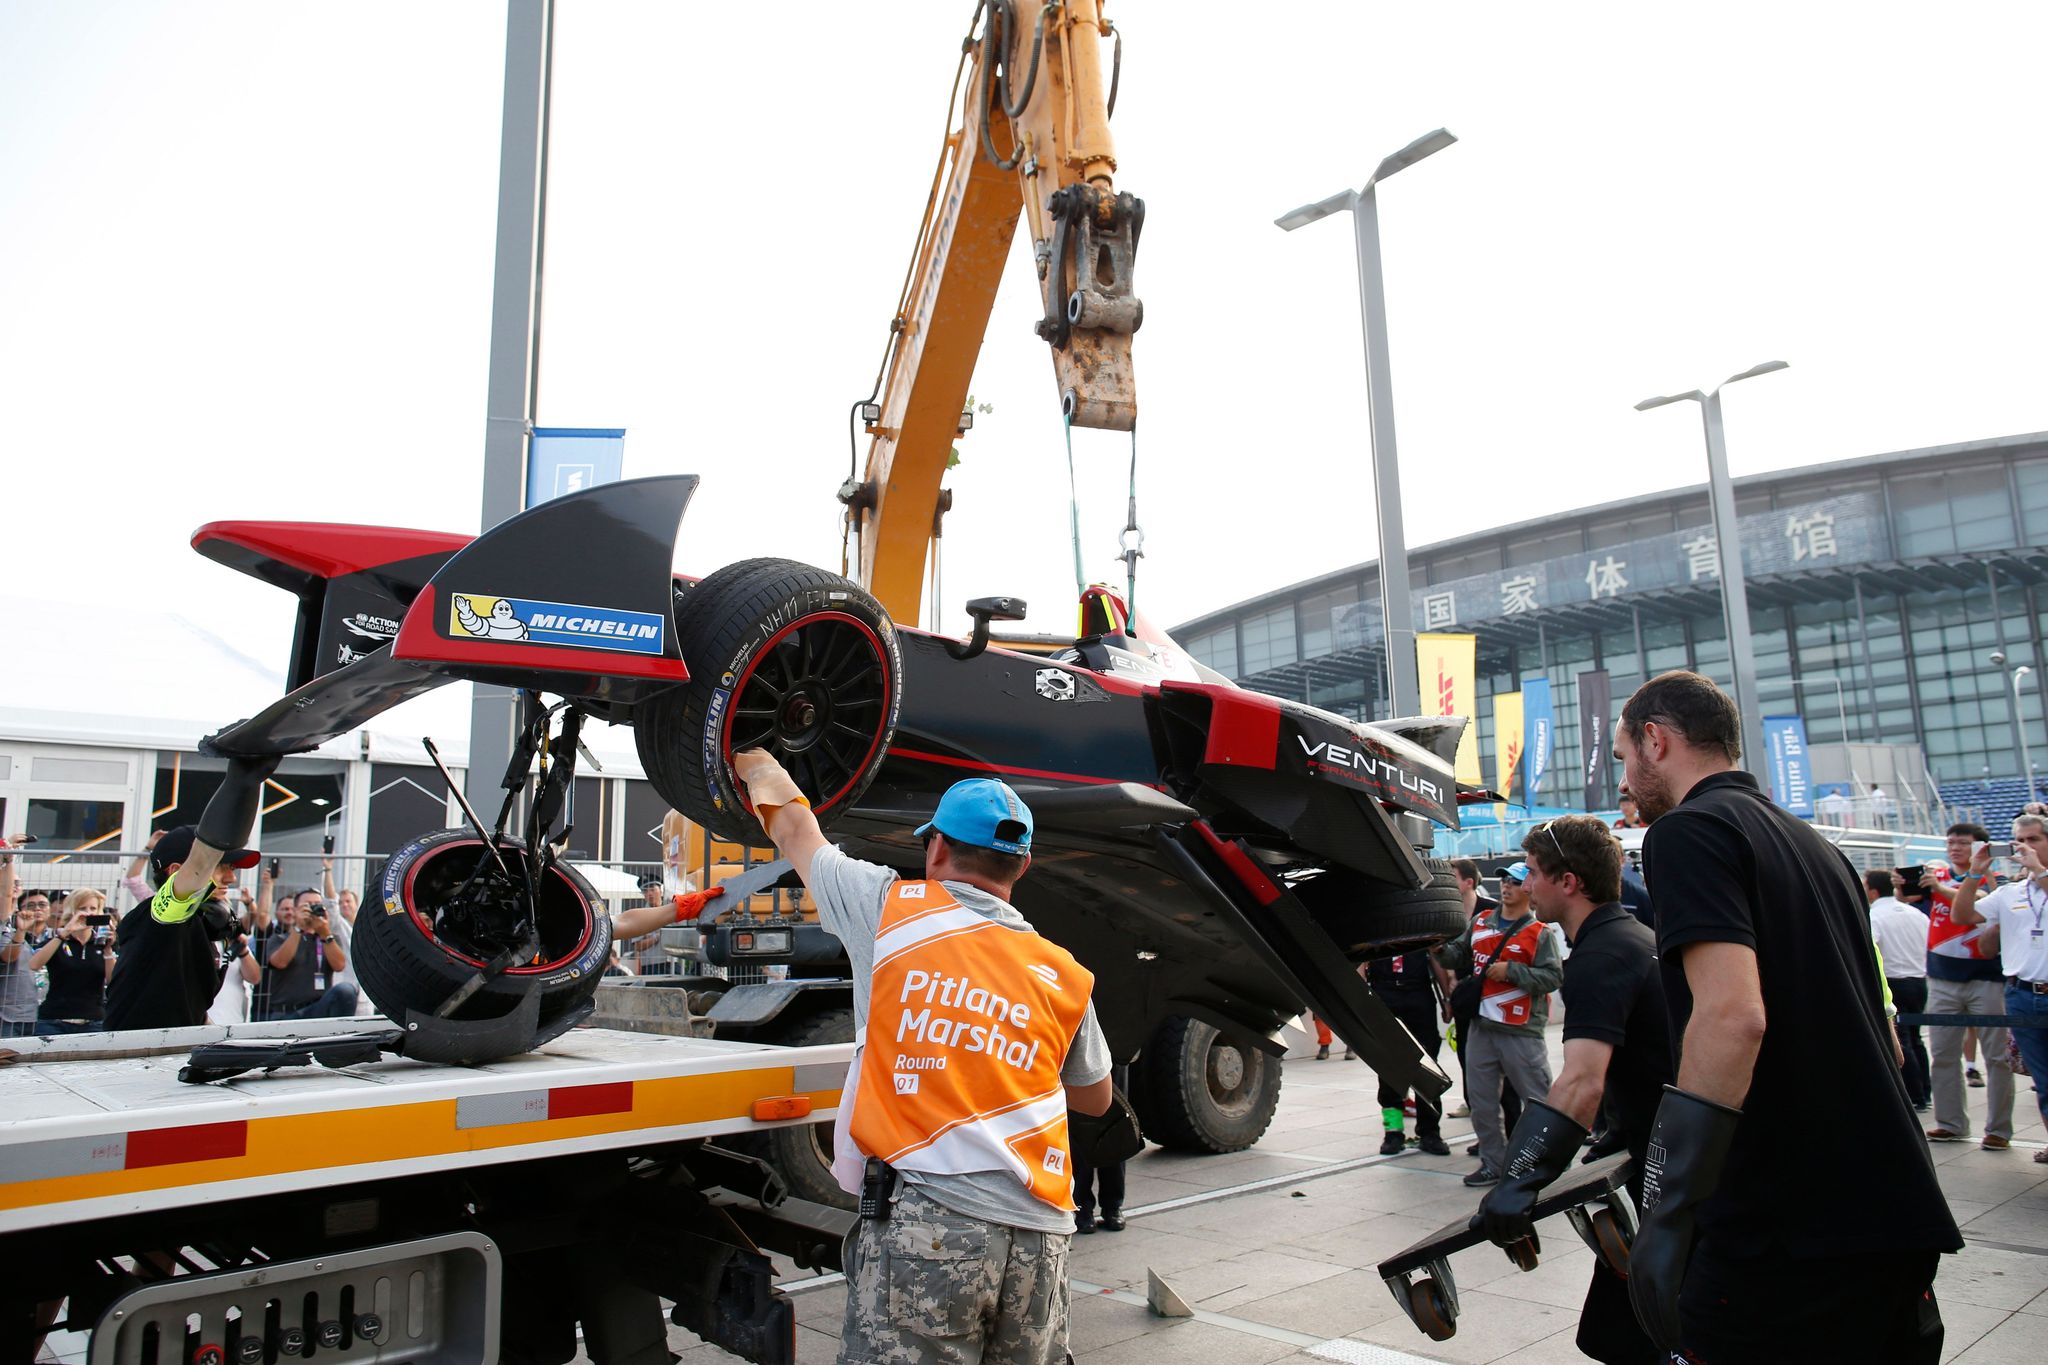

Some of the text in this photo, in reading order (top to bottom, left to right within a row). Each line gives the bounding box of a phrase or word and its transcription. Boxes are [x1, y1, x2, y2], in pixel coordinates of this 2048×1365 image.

[1423, 511, 1839, 631] 国家体育馆
[366, 622, 385, 632] ROAD
[369, 616, 399, 629] ACTION
[529, 613, 659, 639] MICHELIN
[729, 642, 749, 671] MICHELIN
[891, 643, 903, 723] MICHELIN
[1297, 735, 1444, 804] VENTURI
[1535, 720, 1546, 776] MICHELIN
[385, 843, 418, 892] MICHELIN
[903, 886, 922, 896] PL
[582, 920, 608, 971] MICHELIN
[900, 969, 1031, 1029] Pitlane
[894, 1053, 947, 1071] Round
[895, 1008, 1040, 1072] Marshal
[1047, 1153, 1062, 1169] PL
